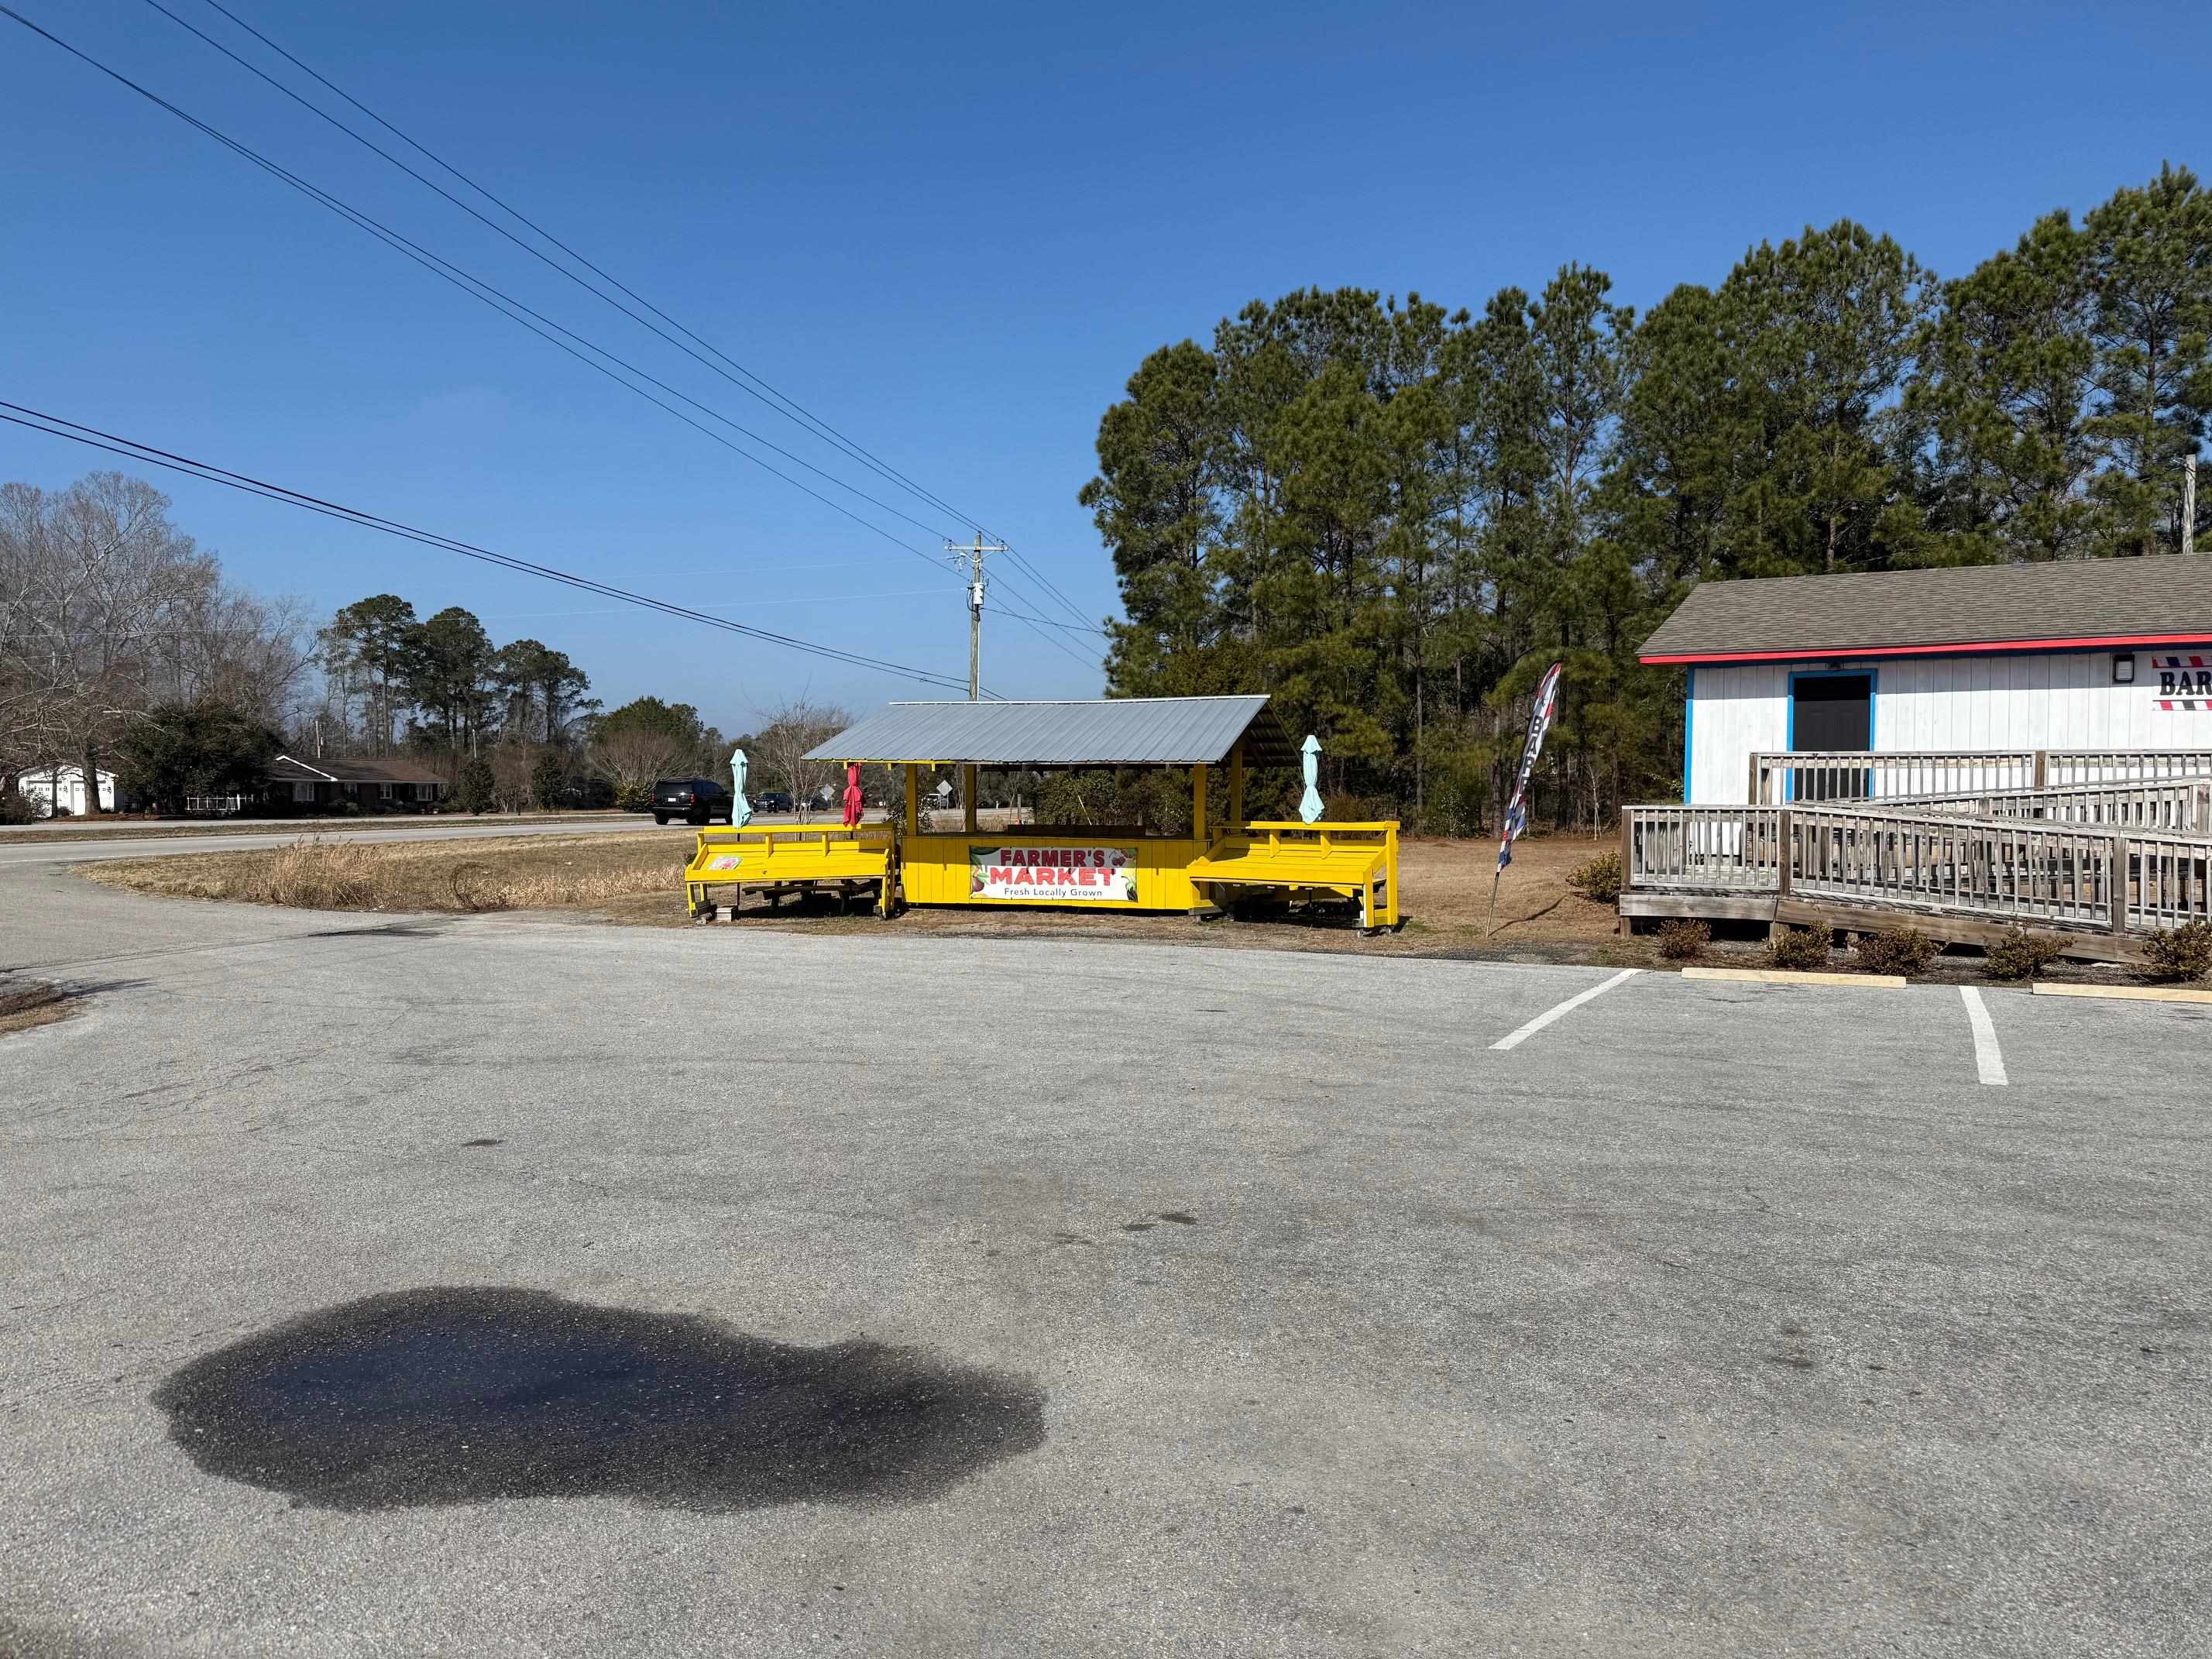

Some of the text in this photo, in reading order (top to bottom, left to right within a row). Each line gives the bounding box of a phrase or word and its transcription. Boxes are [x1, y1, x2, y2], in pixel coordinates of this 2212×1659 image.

[1000, 850, 1104, 867] FARMER'S
[990, 867, 1113, 886] MARKET
[1005, 888, 1029, 896] Fresh
[1033, 888, 1066, 898] Locally
